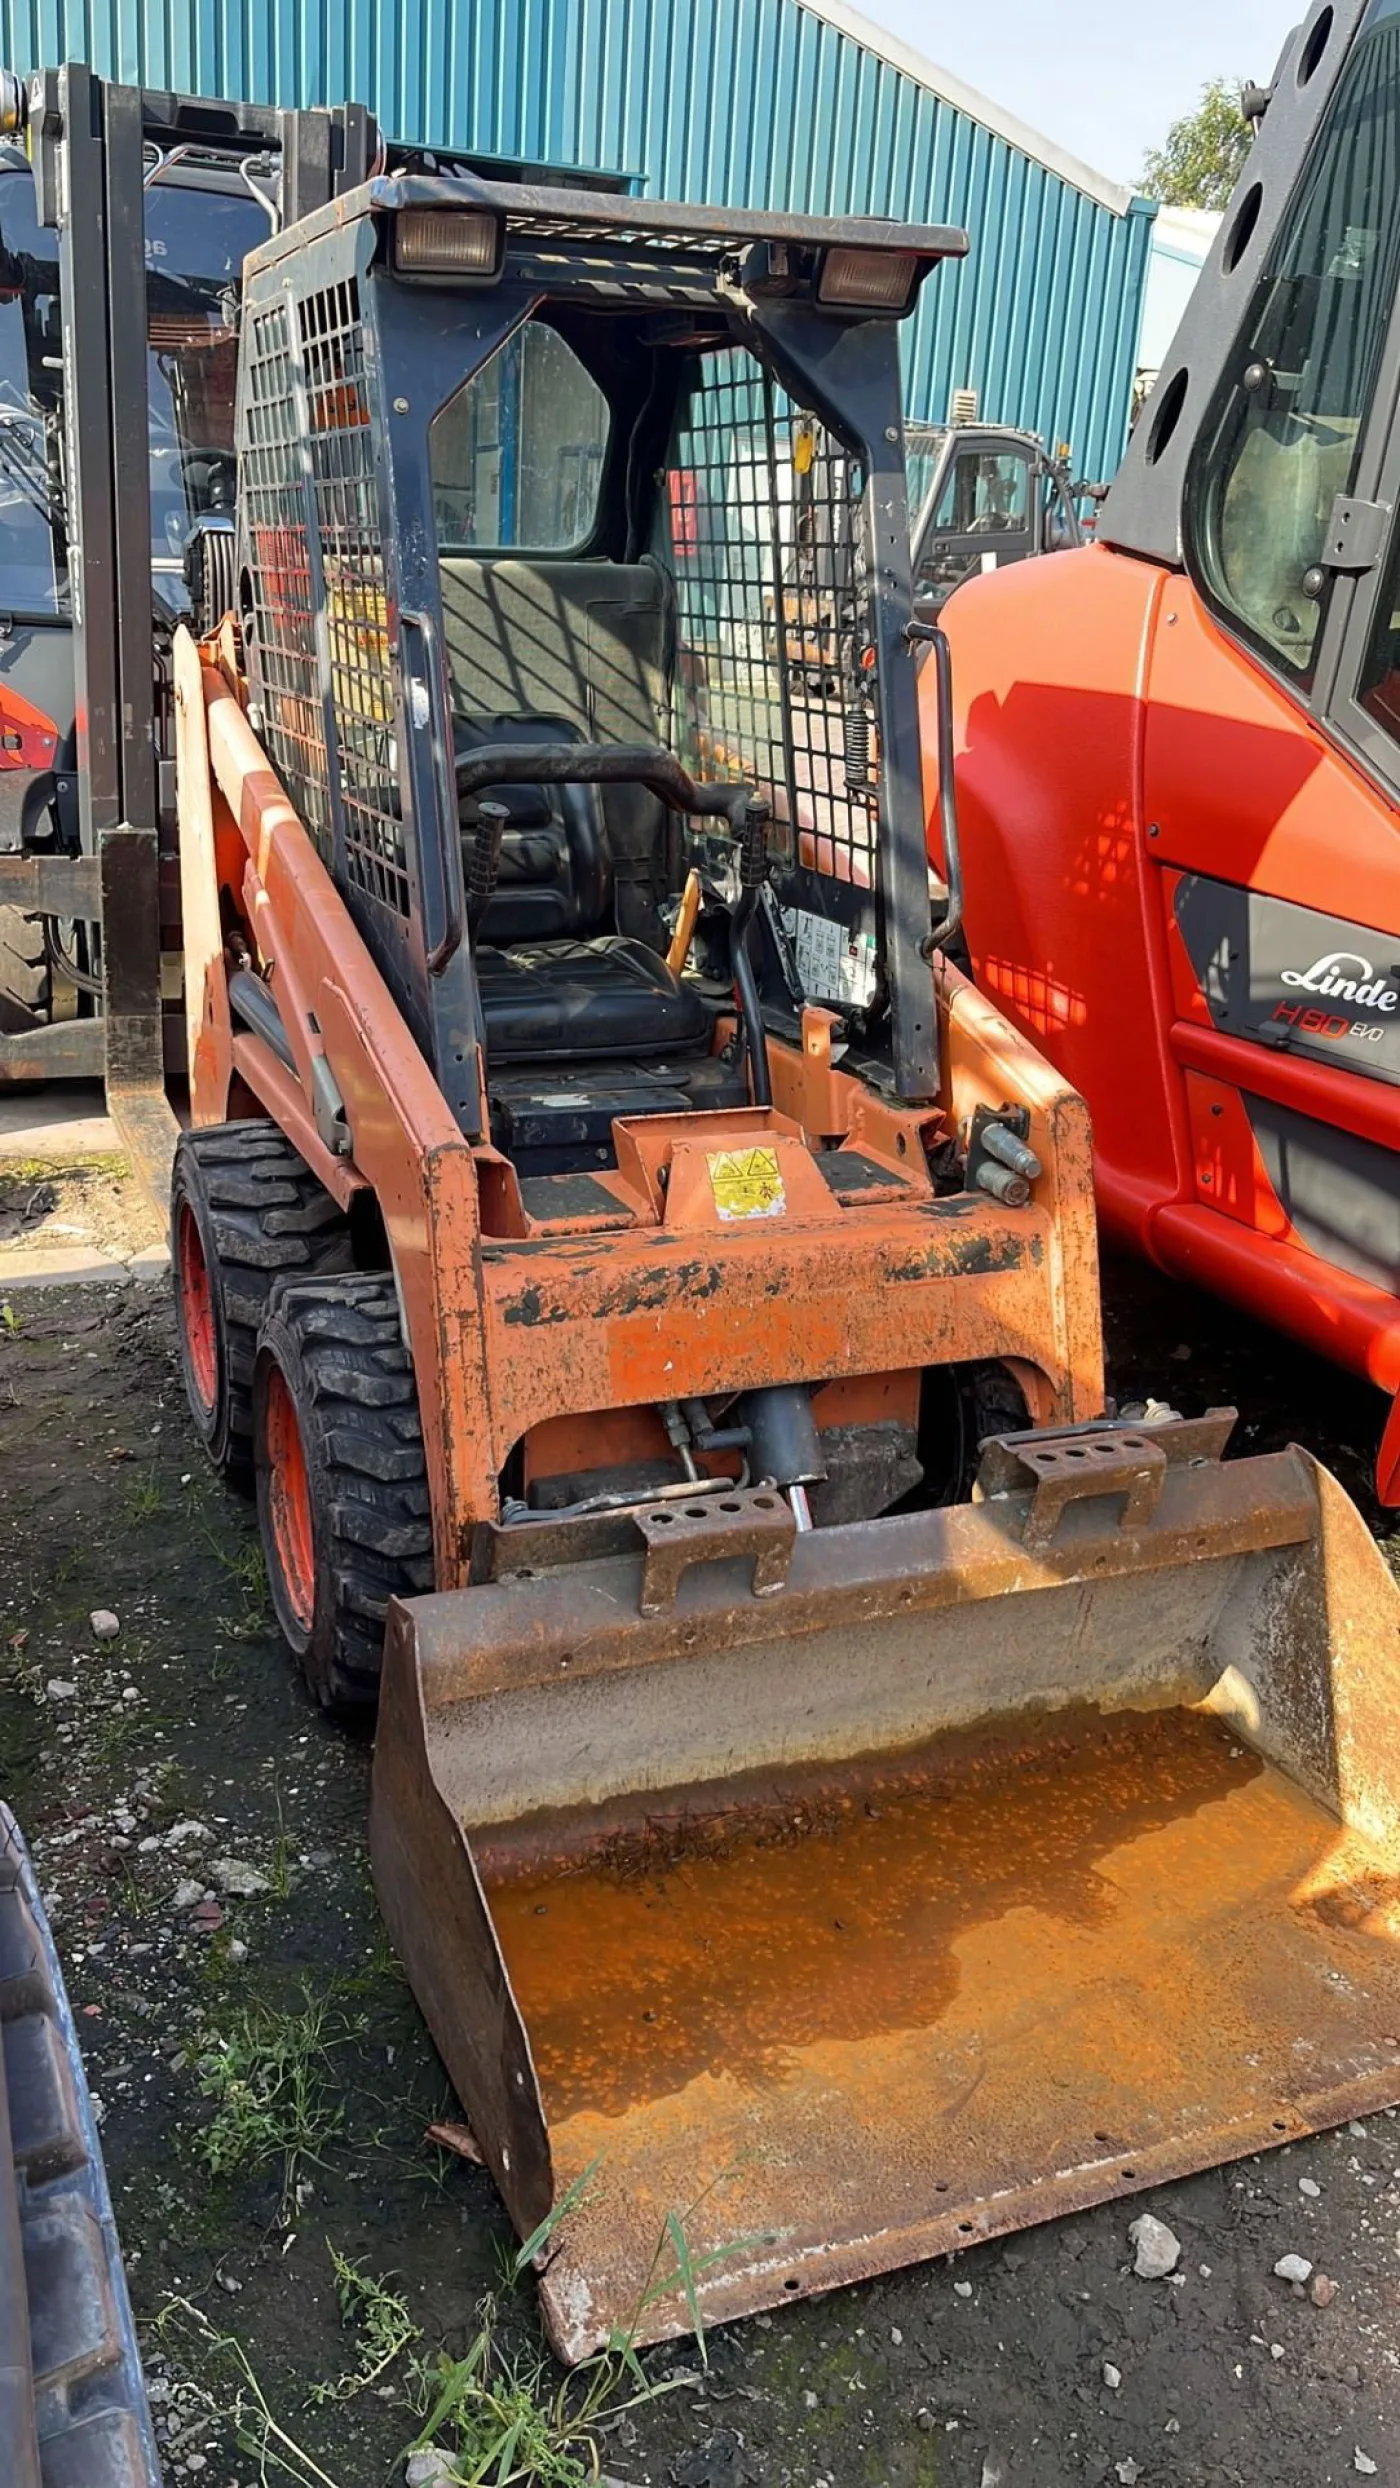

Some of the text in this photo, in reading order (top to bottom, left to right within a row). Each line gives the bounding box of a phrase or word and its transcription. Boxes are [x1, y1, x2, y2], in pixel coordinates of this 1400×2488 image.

[1281, 952, 1398, 1012] Linde
[1271, 1001, 1384, 1041] H80 EVO
